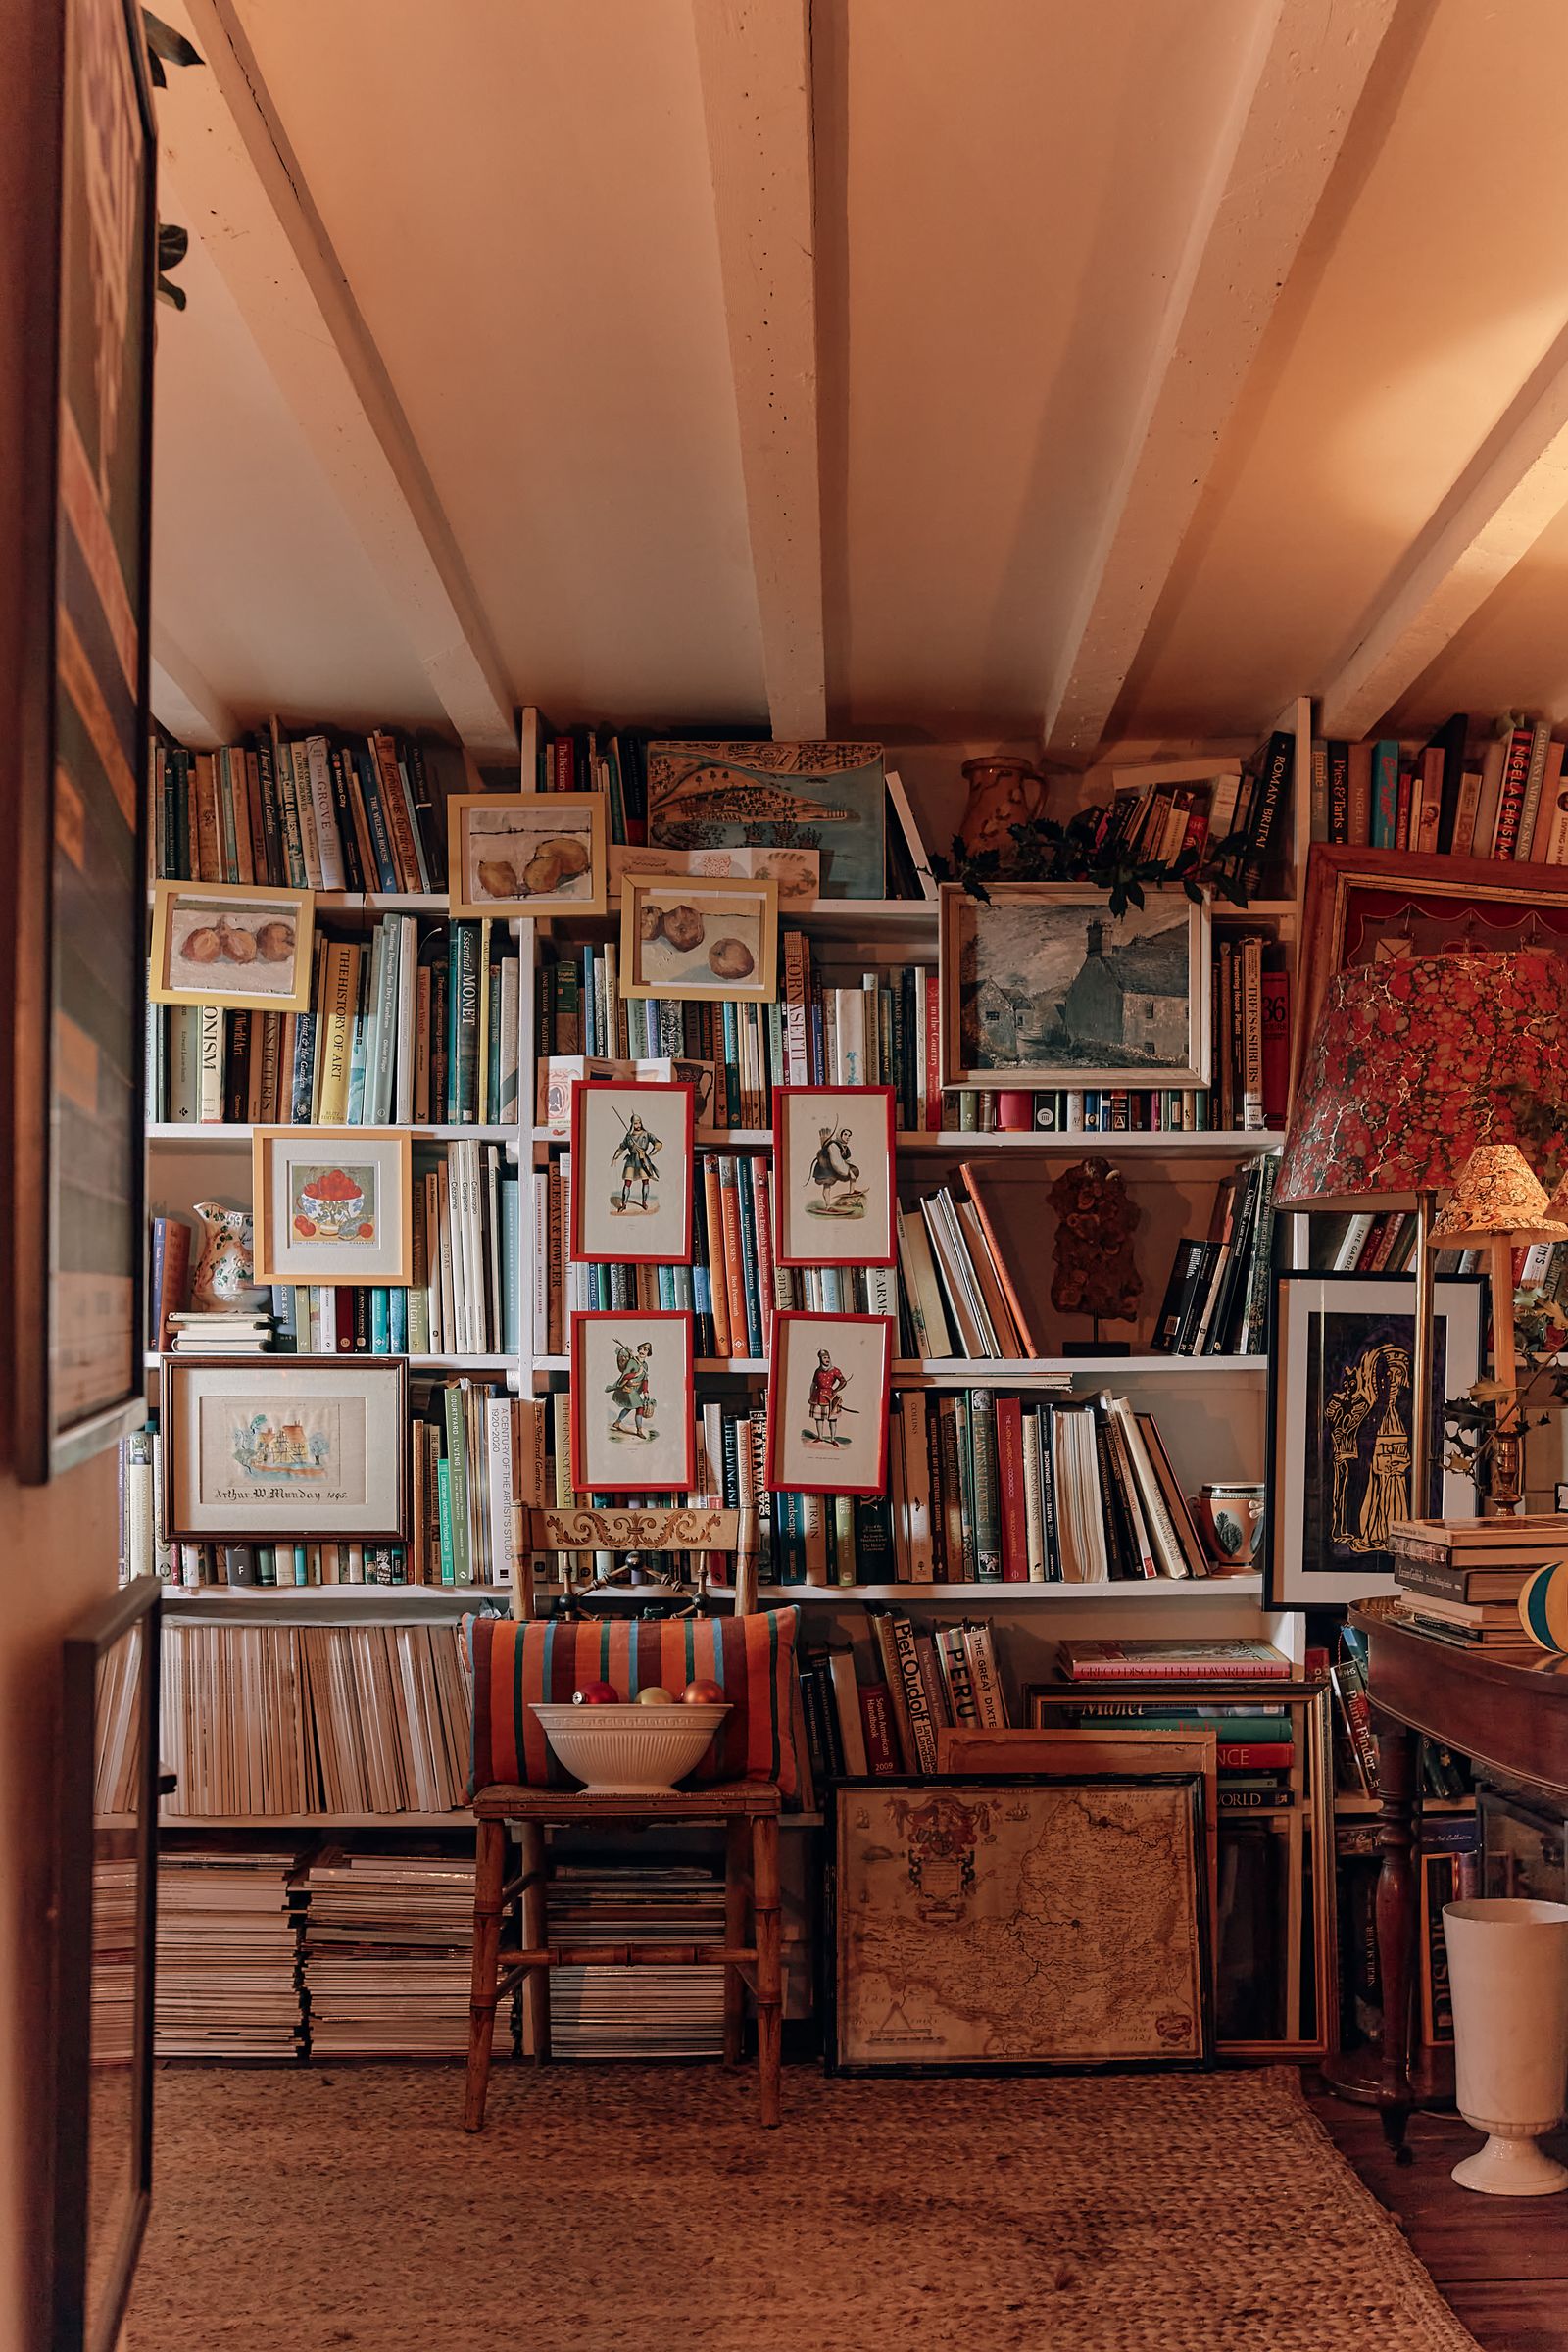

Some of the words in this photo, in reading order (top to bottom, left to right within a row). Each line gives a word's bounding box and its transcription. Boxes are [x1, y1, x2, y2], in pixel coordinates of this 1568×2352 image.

[1532, 729, 1547, 777] GARDENS
[335, 769, 344, 793] Mexico
[1268, 755, 1286, 809] ROMAN
[1508, 745, 1527, 797] NIGELLA
[318, 781, 331, 829] GROVE
[337, 794, 346, 808] City
[369, 796, 378, 811] THE
[1526, 778, 1540, 809] UNDER
[372, 813, 383, 838] WELSH
[1355, 787, 1366, 833] NIGELLA
[1523, 811, 1535, 829] BIG
[1255, 808, 1277, 848] BRITAI
[1498, 800, 1518, 861] CHRISTMA
[379, 840, 389, 864] HOUSE
[1519, 831, 1532, 859] SKIES
[1558, 845, 1564, 855] IN
[387, 923, 398, 951] Planting
[463, 930, 473, 972] Essential
[338, 949, 351, 976] THE
[386, 952, 396, 974] Design
[1233, 955, 1242, 989] Flowering
[334, 977, 350, 1033] HISTORY
[384, 987, 394, 1000] Dry
[462, 974, 476, 1026] MONET
[786, 955, 806, 1061] FORNASETTI
[1248, 985, 1259, 1025] TREES
[383, 1002, 393, 1029] Gardens
[435, 1006, 444, 1036] amazing
[931, 1005, 936, 1015] in
[234, 1014, 246, 1041] World
[302, 1038, 310, 1048] &
[333, 1034, 344, 1051] OF
[234, 1042, 245, 1056] Art
[435, 1037, 444, 1062] gardens
[928, 1032, 939, 1066] Country
[1249, 1034, 1258, 1082] SHRUBS
[299, 1060, 308, 1089] Garden
[331, 1054, 344, 1081] ART
[552, 1165, 562, 1222] COLEFAX
[1265, 1162, 1274, 1195] GARDENS
[470, 1181, 479, 1214] Caravaggio
[710, 1183, 718, 1216] ENGLISH
[725, 1192, 735, 1229] ENGLISH
[1264, 1196, 1270, 1204] OF
[552, 1225, 560, 1235] &
[711, 1217, 720, 1264] DECORATION
[728, 1230, 737, 1262] HOUSES
[744, 1213, 753, 1258] inspirational
[759, 1219, 767, 1246] English
[552, 1238, 562, 1288] FOWLER
[730, 1275, 739, 1288] Ben
[777, 1274, 793, 1298] and
[450, 1394, 460, 1435] COURTYARD
[453, 1439, 462, 1467] LIVING
[534, 1424, 544, 1460] Sheltered
[975, 1426, 986, 1465] PLANTS
[502, 1458, 510, 1470] OF
[534, 1461, 543, 1491] Garden
[563, 1458, 570, 1474] OF
[750, 1421, 766, 1517] RAILWAYS
[1099, 1448, 1109, 1484] CONTAINED
[215, 1488, 250, 1501] Arthur
[270, 1488, 320, 1501] Munday
[564, 1476, 572, 1507] VENICE
[1102, 1484, 1111, 1506] GARDEN
[502, 1491, 511, 1527] ARTIST'S
[809, 1504, 820, 1539] TRAIN
[896, 1623, 915, 1657] Piet
[974, 1638, 984, 1657] THE
[883, 1626, 897, 1669] CHELSEA
[892, 1674, 904, 1703] GOLD
[977, 1660, 990, 1692] GREAT
[1080, 1666, 1121, 1677] GRECO
[1122, 1666, 1157, 1677] DISCO
[1164, 1666, 1194, 1677] LUKE
[1198, 1666, 1245, 1676] EDWARD
[1247, 1665, 1275, 1676] HALL
[903, 1660, 929, 1723] Oudolf
[922, 1651, 931, 1663] The
[932, 1703, 942, 1728] English
[947, 1648, 977, 1719] PERU
[866, 1698, 878, 1739] Handbook
[876, 1697, 886, 1720] South
[984, 1697, 997, 1729] DIXTE
[878, 1721, 890, 1756] American
[1346, 1690, 1363, 1726] Plant
[1355, 1726, 1377, 1771] Finder
[875, 1763, 894, 1772] 2009
